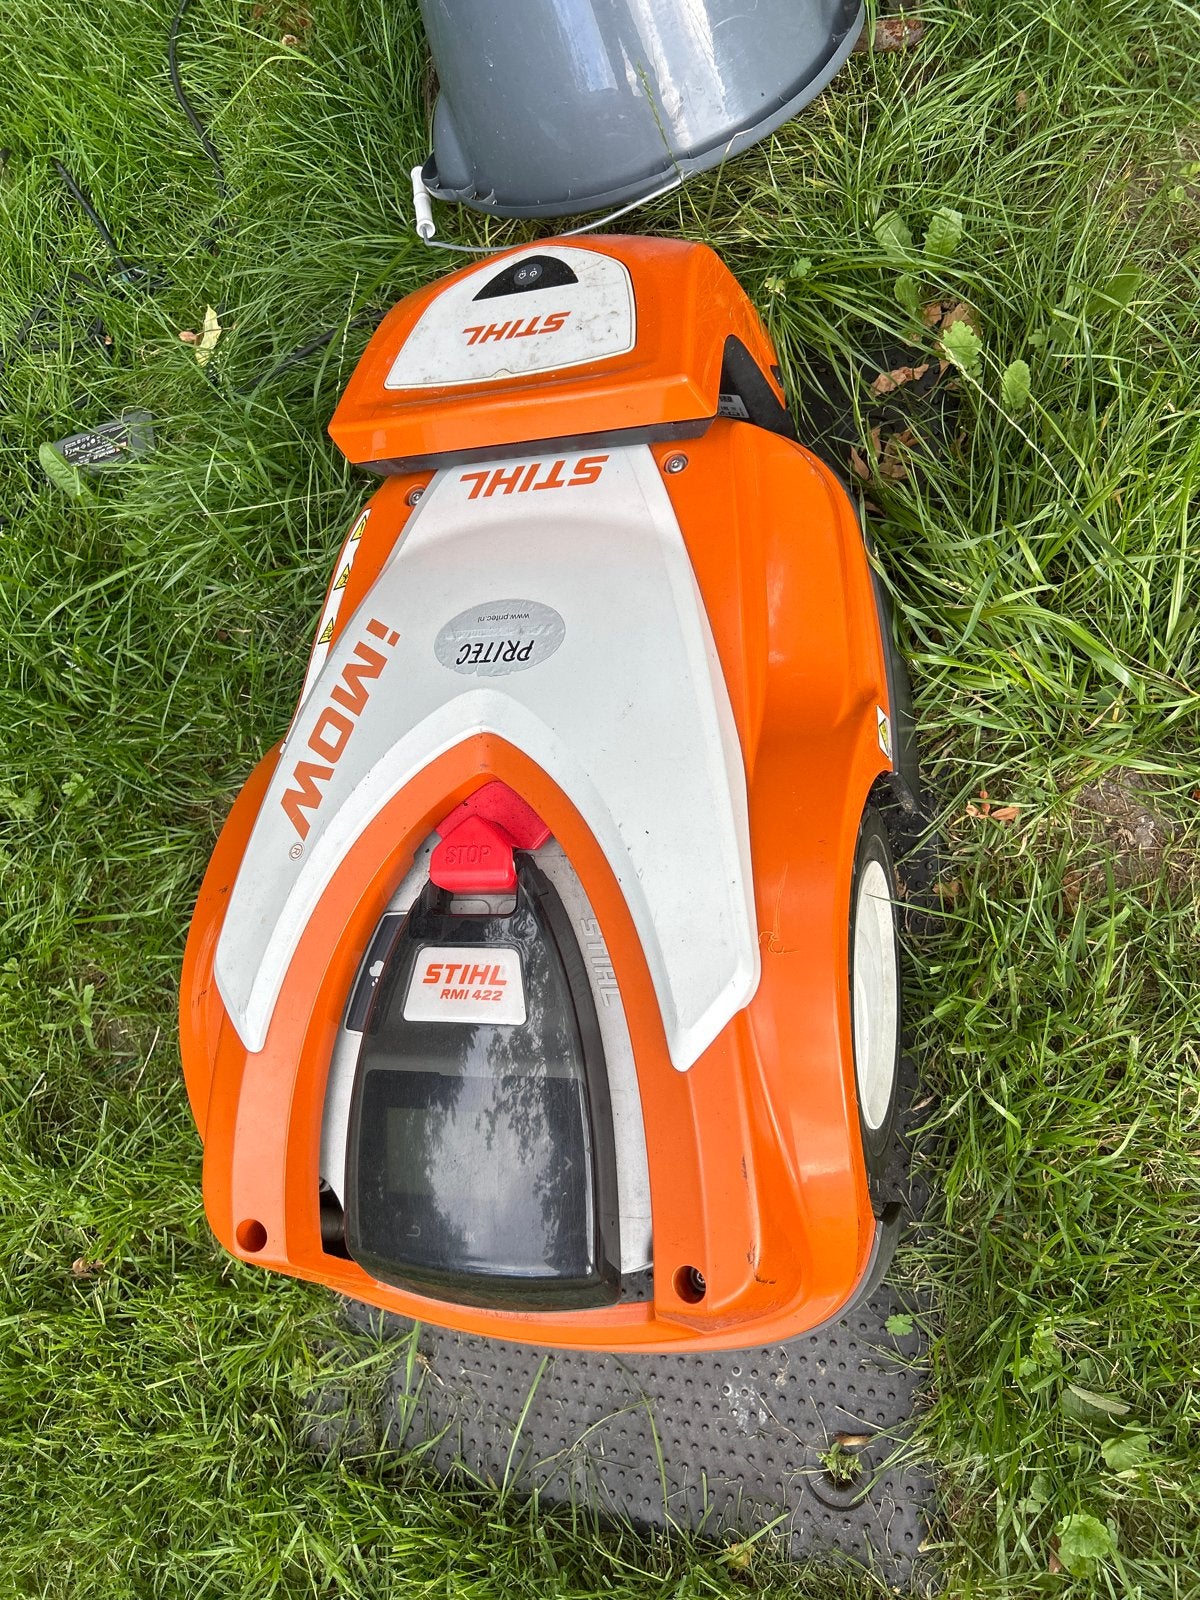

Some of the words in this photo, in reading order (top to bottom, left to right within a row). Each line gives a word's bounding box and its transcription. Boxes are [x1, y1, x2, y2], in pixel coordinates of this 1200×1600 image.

[462, 311, 572, 346] STIHL
[459, 454, 610, 500] STIHL
[477, 613, 530, 623] www.pritec.nl
[456, 640, 535, 665] PRITEC
[280, 618, 400, 842] iMOW
[445, 845, 492, 865] STOP
[422, 963, 507, 986] STIHL
[580, 917, 620, 1007] STIHL
[440, 988, 470, 1000] RMI
[471, 989, 503, 1001] 422
